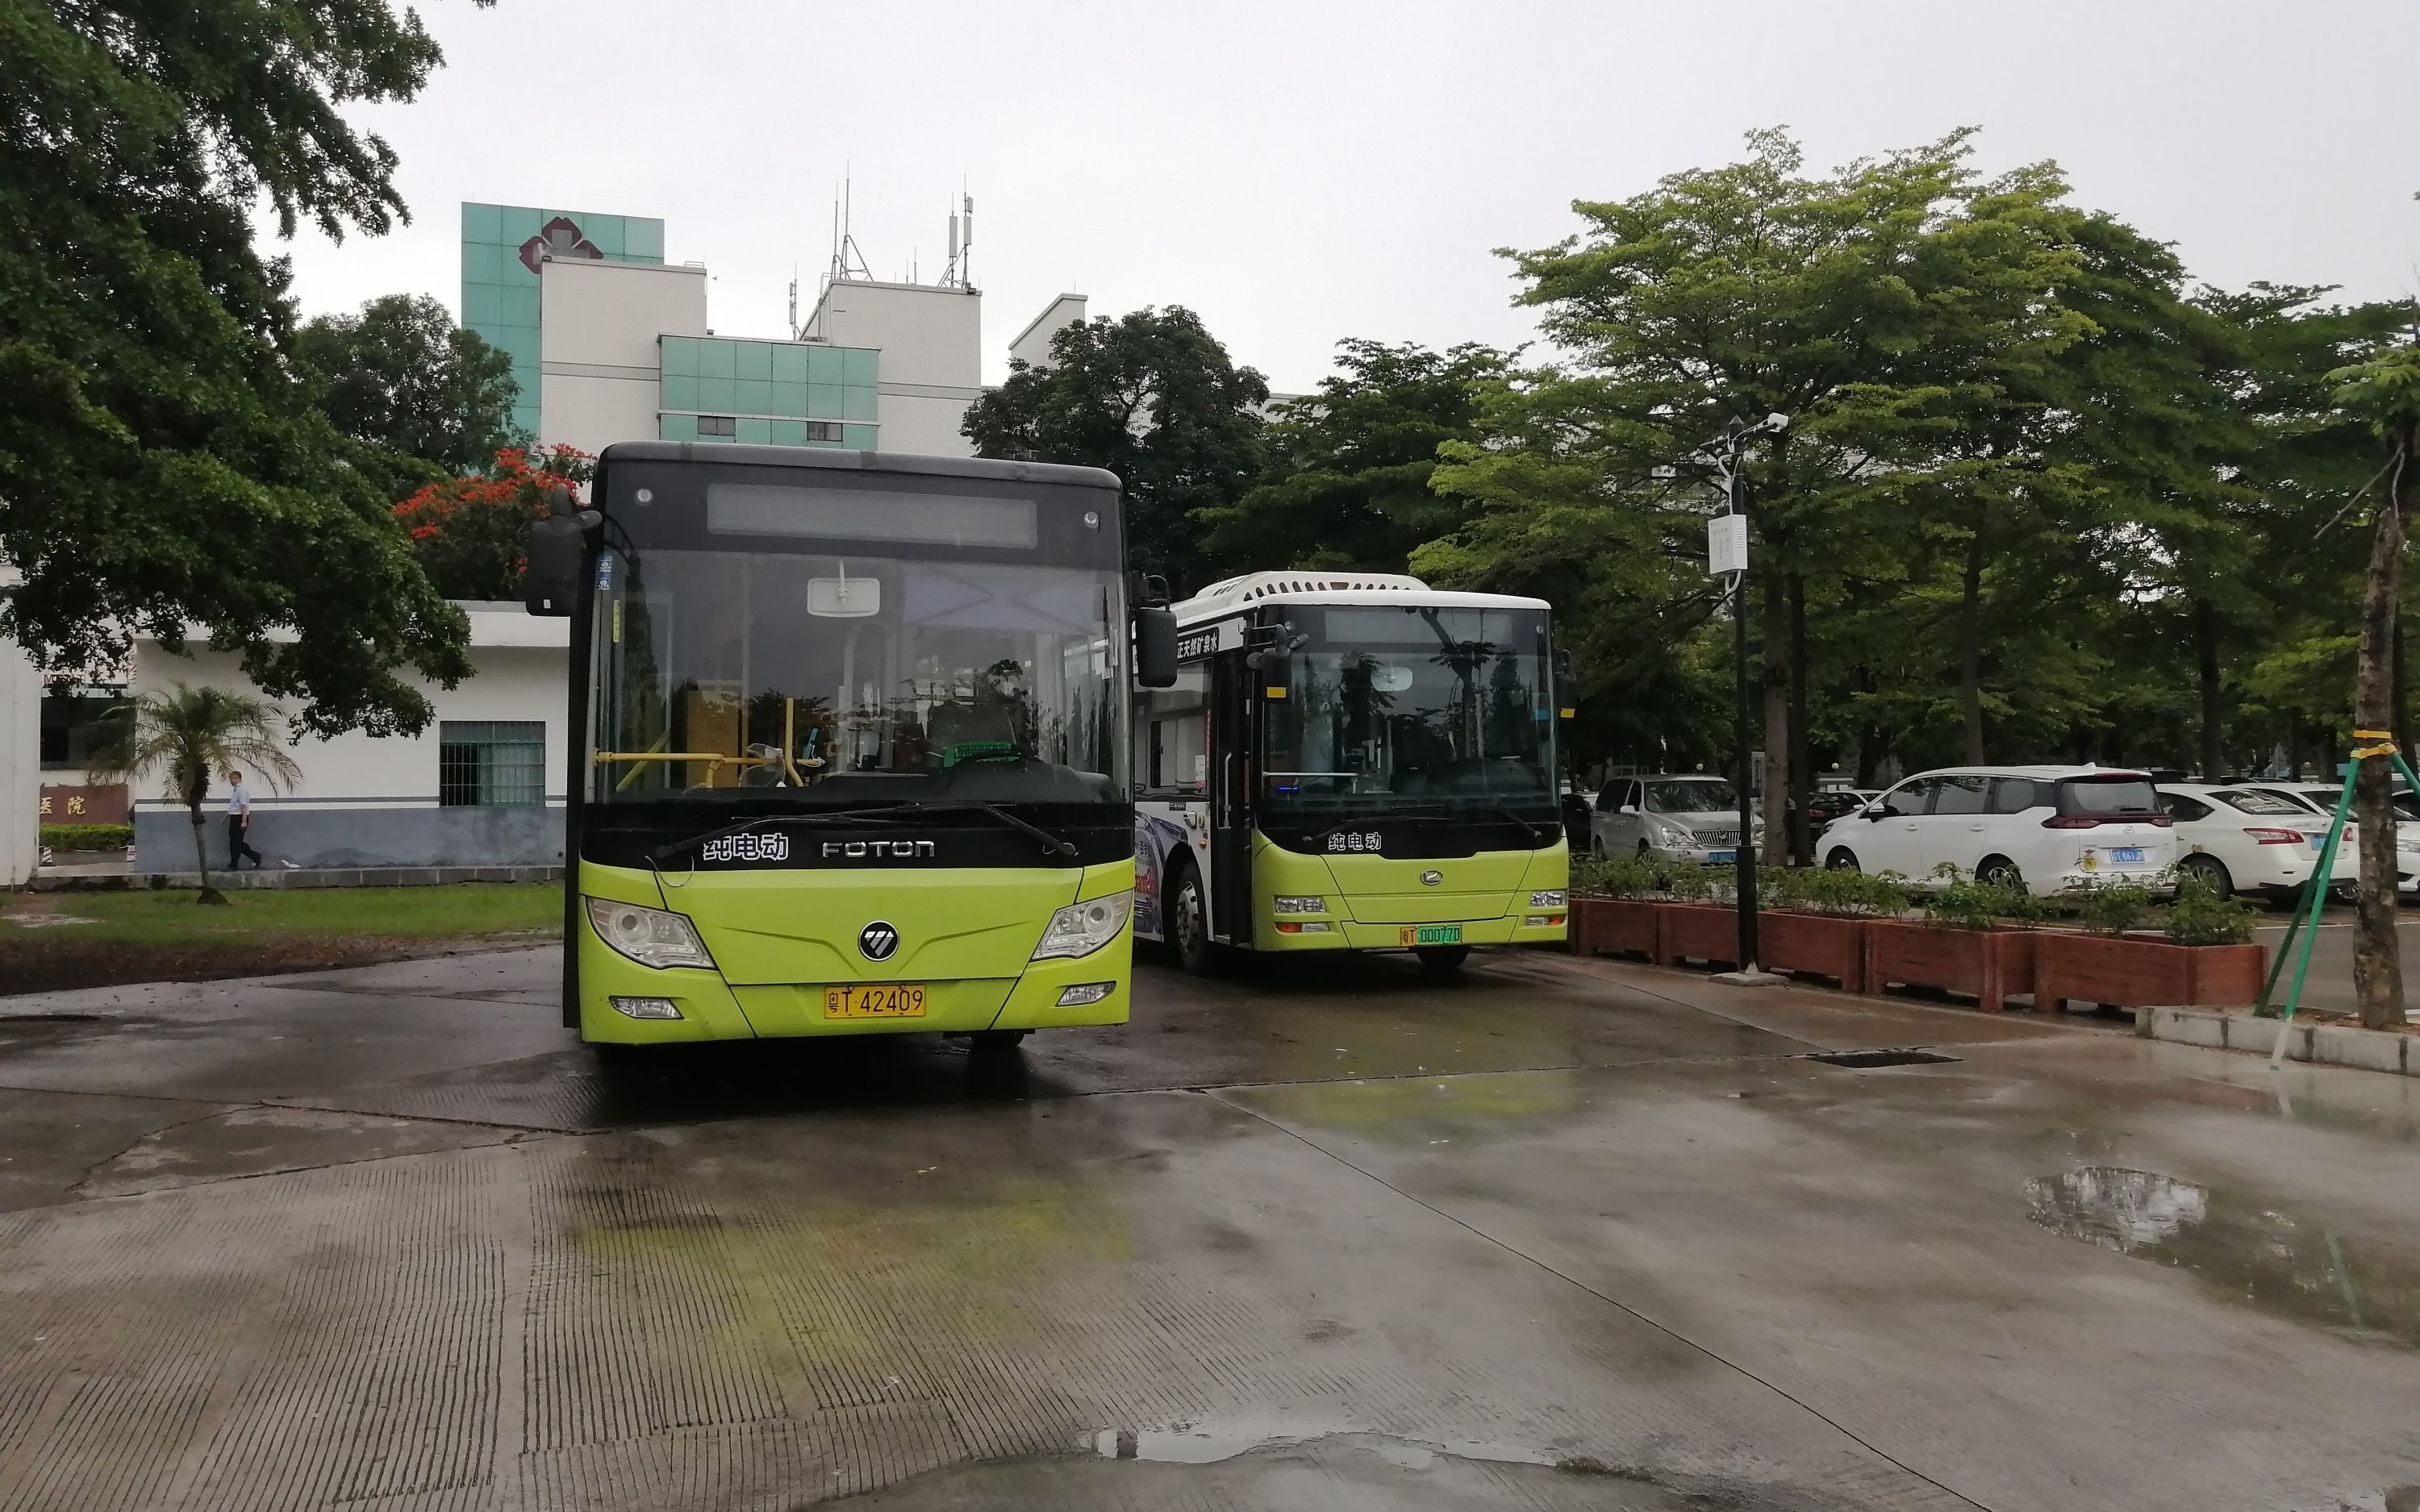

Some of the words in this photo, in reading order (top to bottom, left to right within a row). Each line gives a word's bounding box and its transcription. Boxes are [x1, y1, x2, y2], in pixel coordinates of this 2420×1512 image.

[39, 796, 86, 815] 医院
[703, 833, 789, 861] 纯电动
[821, 840, 935, 858] FOTON
[1328, 831, 1382, 852] 纯电动
